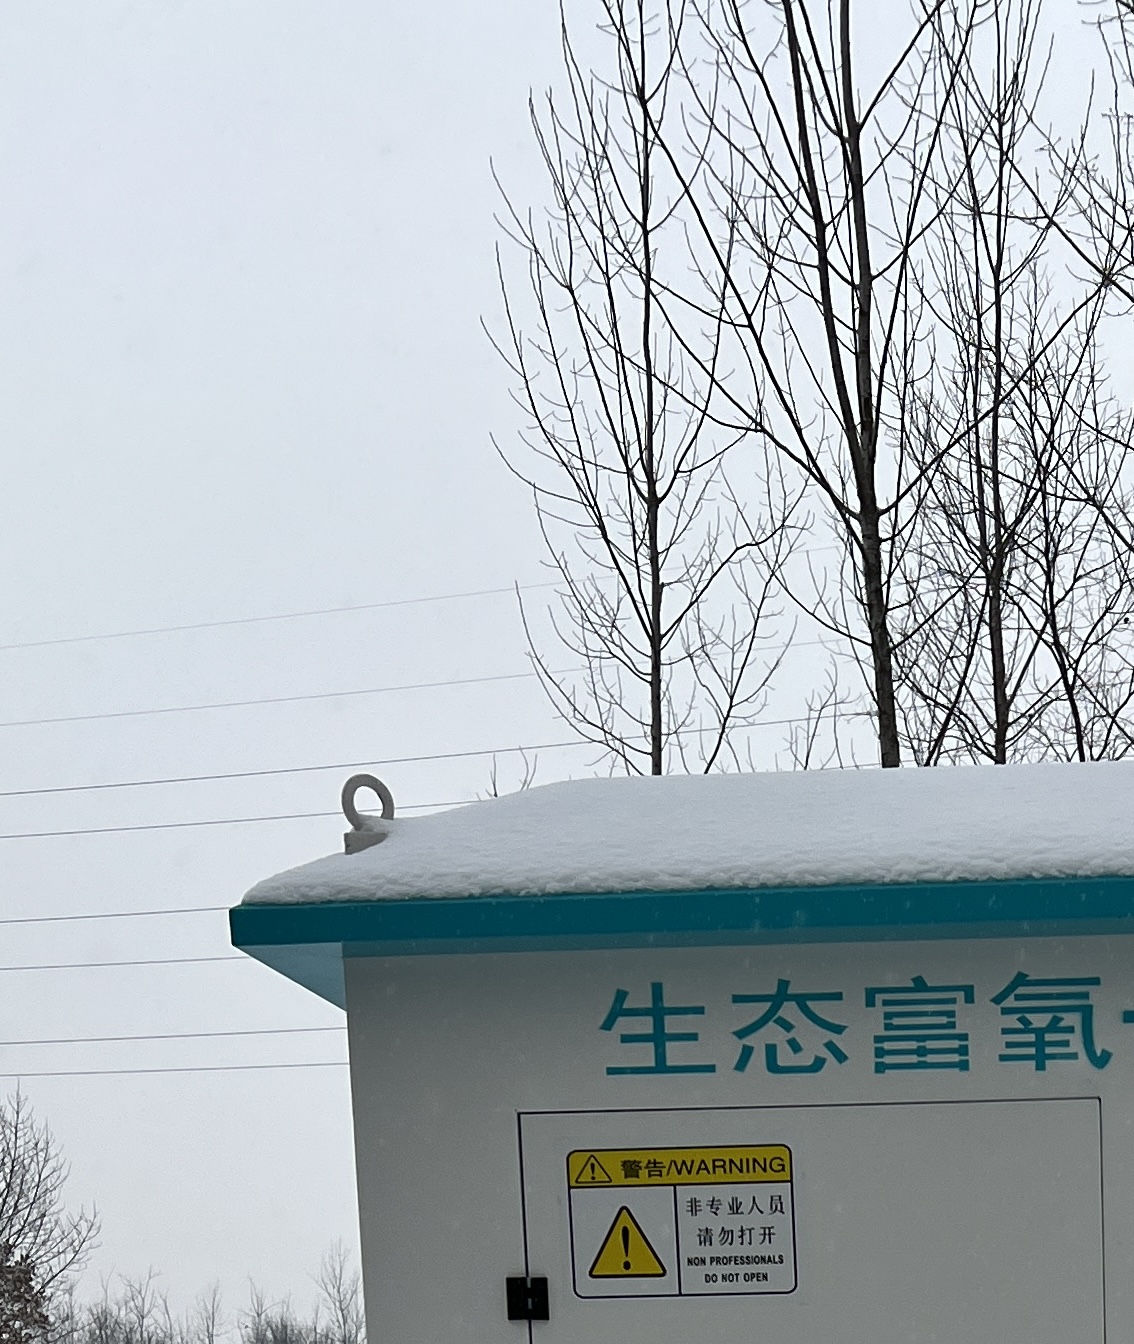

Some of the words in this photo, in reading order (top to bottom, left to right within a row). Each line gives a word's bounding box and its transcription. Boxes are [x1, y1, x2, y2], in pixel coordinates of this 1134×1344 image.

[685, 1194, 786, 1217] 非专业人员
[696, 1225, 777, 1247] 请勿打开
[687, 1256, 706, 1267] NON
[709, 1254, 785, 1266] PROFESSIONALS
[704, 1273, 719, 1284] DO
[721, 1273, 740, 1283] NOT
[743, 1272, 769, 1283] OPEN
